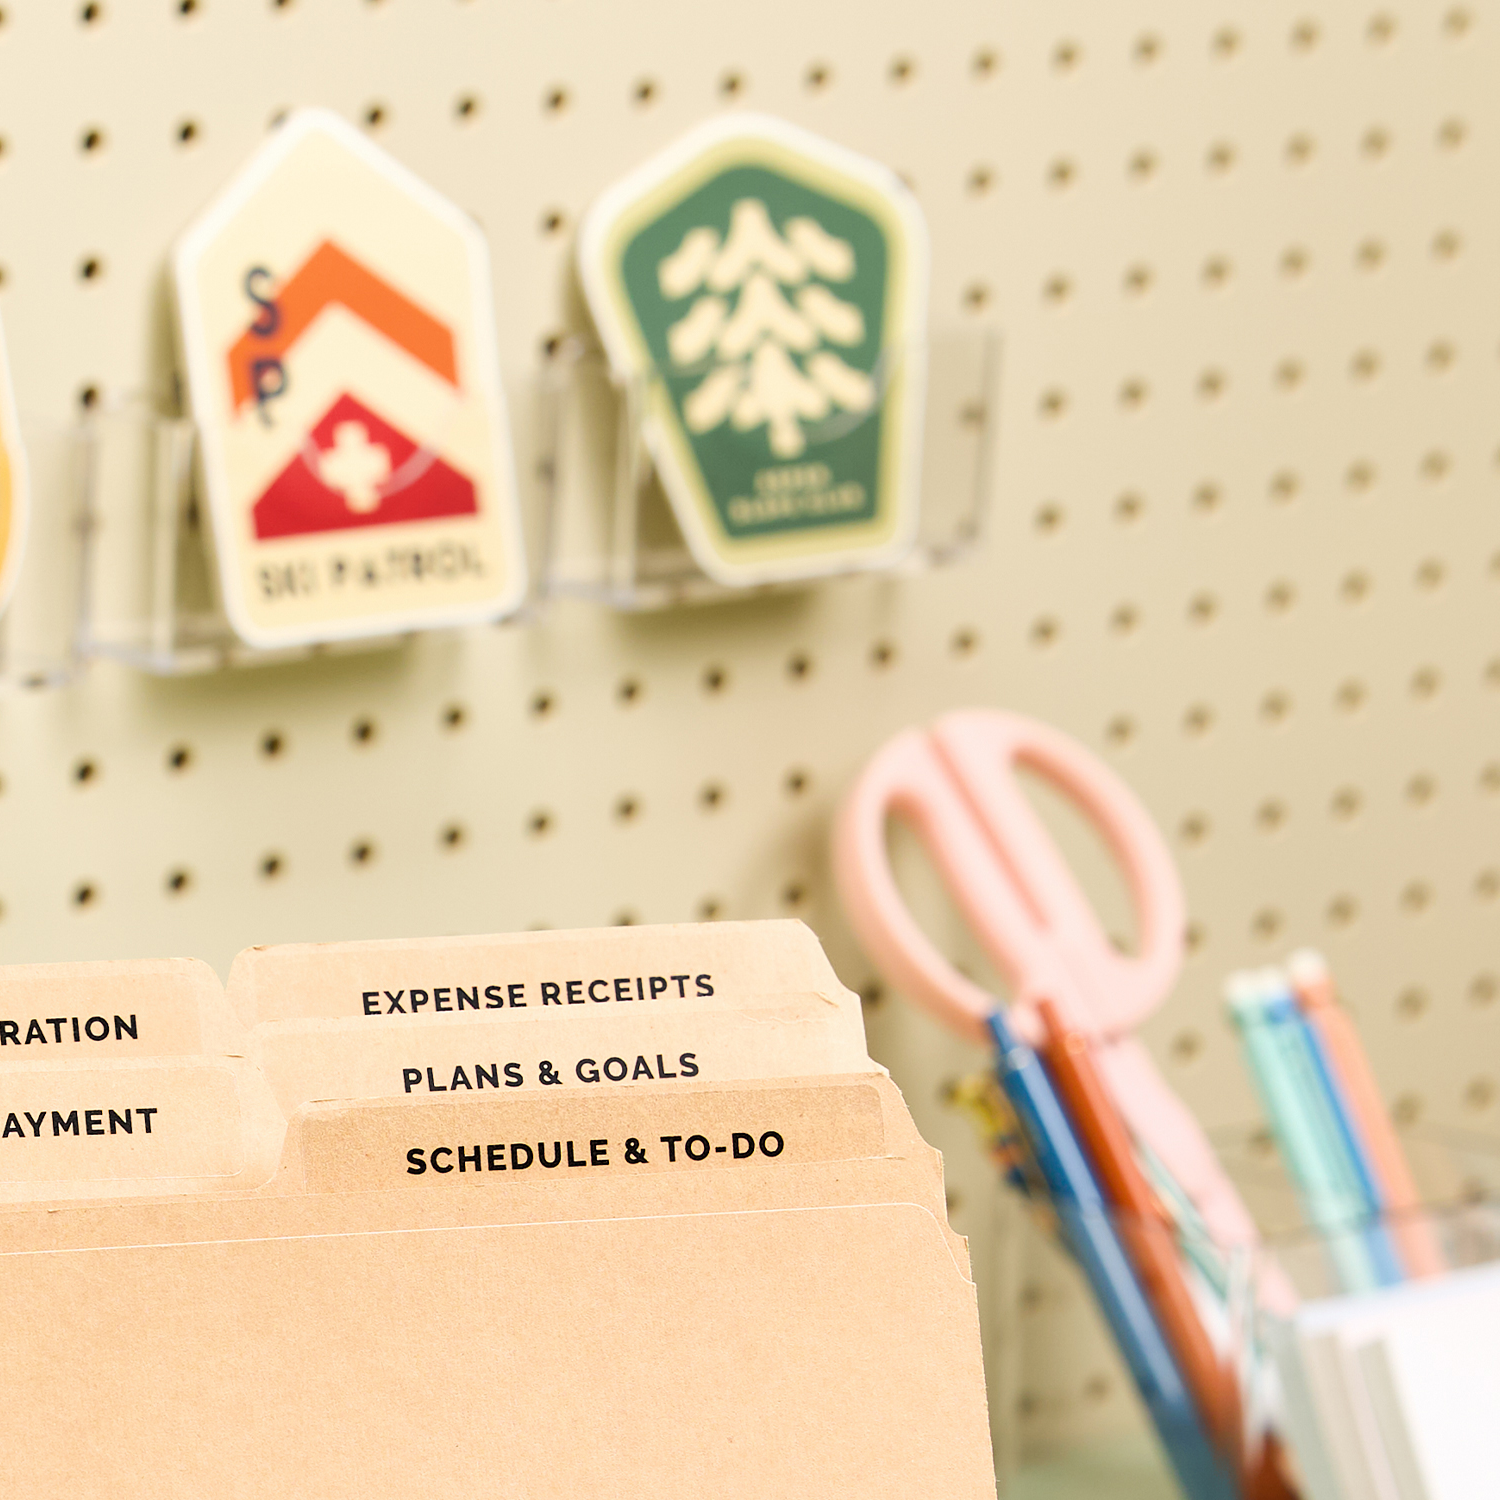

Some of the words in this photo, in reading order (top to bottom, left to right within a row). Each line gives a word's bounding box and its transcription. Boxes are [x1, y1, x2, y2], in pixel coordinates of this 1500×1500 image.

[259, 559, 318, 601] SKI
[334, 541, 487, 589] PATROL
[362, 983, 527, 1016] EXPENSE
[540, 974, 715, 1006] RECEIPTS
[402, 1062, 524, 1094] PLANS
[538, 1060, 563, 1086] &
[575, 1052, 700, 1083] GOALS
[406, 1138, 610, 1175] SCHEDULE
[624, 1137, 649, 1165] &
[659, 1130, 785, 1163] TO-DO
